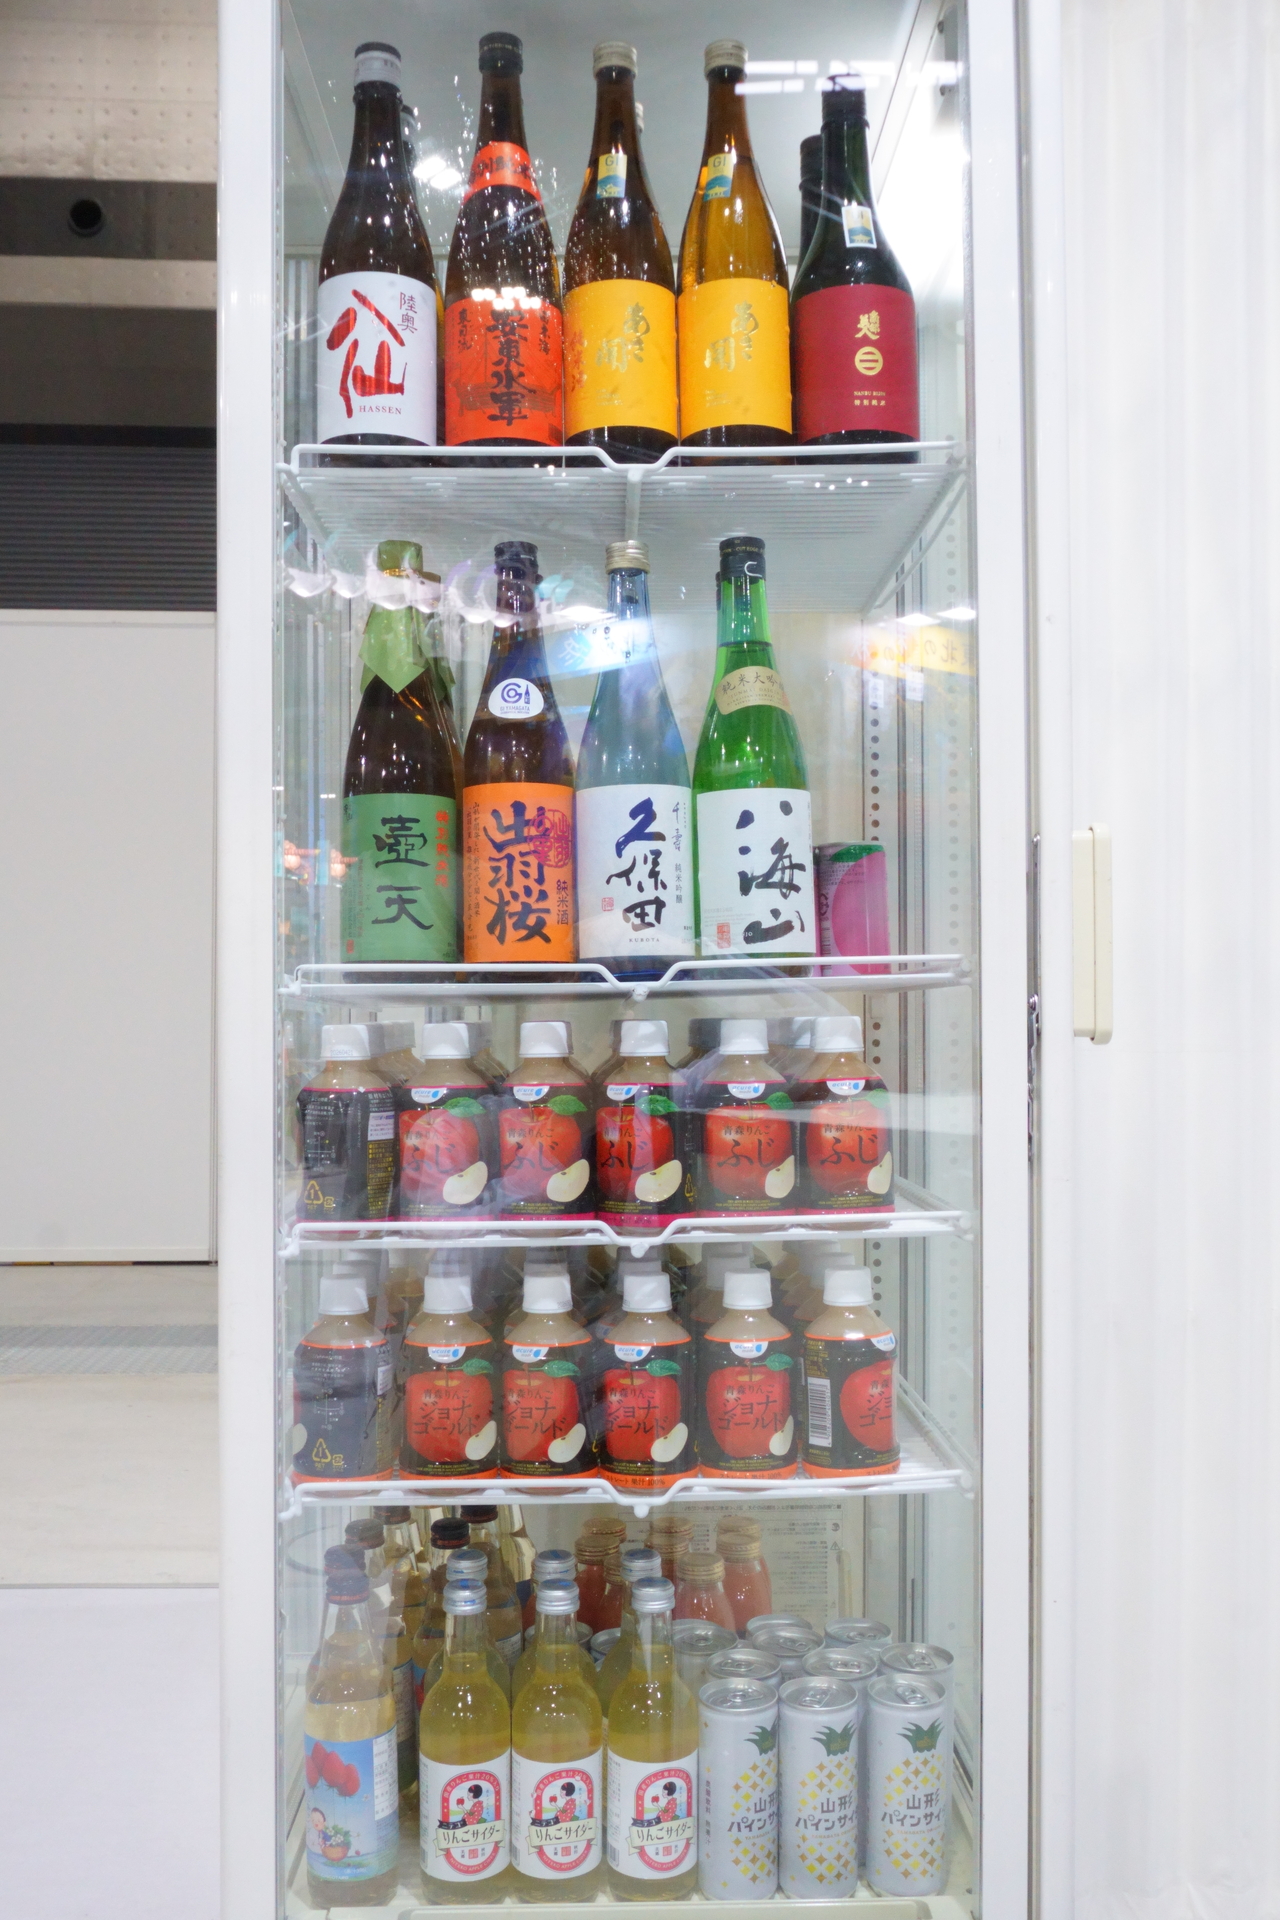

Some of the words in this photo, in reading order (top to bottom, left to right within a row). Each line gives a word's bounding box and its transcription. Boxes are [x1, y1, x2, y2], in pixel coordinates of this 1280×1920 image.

[397, 291, 419, 334] 陸奥
[326, 289, 407, 419] 八仙
[485, 309, 537, 427] 安東水軍
[358, 404, 403, 416] HASSEN
[483, 800, 551, 946] 出羽桜
[606, 797, 668, 933] 久保田
[736, 799, 806, 946] 八海山
[674, 863, 684, 905] 純米吟醸
[556, 879, 569, 926] 純米酒
[507, 1127, 554, 1138] 青森りんご
[723, 1125, 771, 1136] 青森りんご
[824, 1122, 874, 1134] 青森りんご
[401, 1143, 457, 1174] ふじ
[503, 1141, 560, 1172] ふじ
[600, 1141, 651, 1171] ふじ
[716, 1138, 775, 1168] ふじ
[819, 1134, 879, 1165] ふじ
[423, 1389, 471, 1400] 青森りんご
[506, 1387, 553, 1400] 青森りんご
[609, 1389, 657, 1400] 青森りんご
[726, 1384, 775, 1396] 青森りんご
[419, 1399, 473, 1421] ジョナ
[504, 1399, 557, 1421] ジョナ
[605, 1399, 659, 1420] ジョナ
[723, 1394, 778, 1416] ジョナ
[413, 1414, 480, 1437] ゴールド
[505, 1416, 566, 1439] ゴールド
[605, 1415, 669, 1439] ゴールド
[717, 1412, 784, 1433] ゴールド
[631, 1477, 646, 1486] 果汁
[647, 1477, 666, 1486] 100%
[820, 1789, 854, 1814] 山形
[906, 1787, 941, 1810] 山形
[727, 1811, 778, 1833] パインサ
[880, 1807, 945, 1828] パインサイ
[442, 1825, 501, 1845] りんごサイダー
[535, 1821, 593, 1842] りんごサイダー
[636, 1822, 692, 1842] りんごサイダー
[560, 1861, 576, 1869] APPLE
